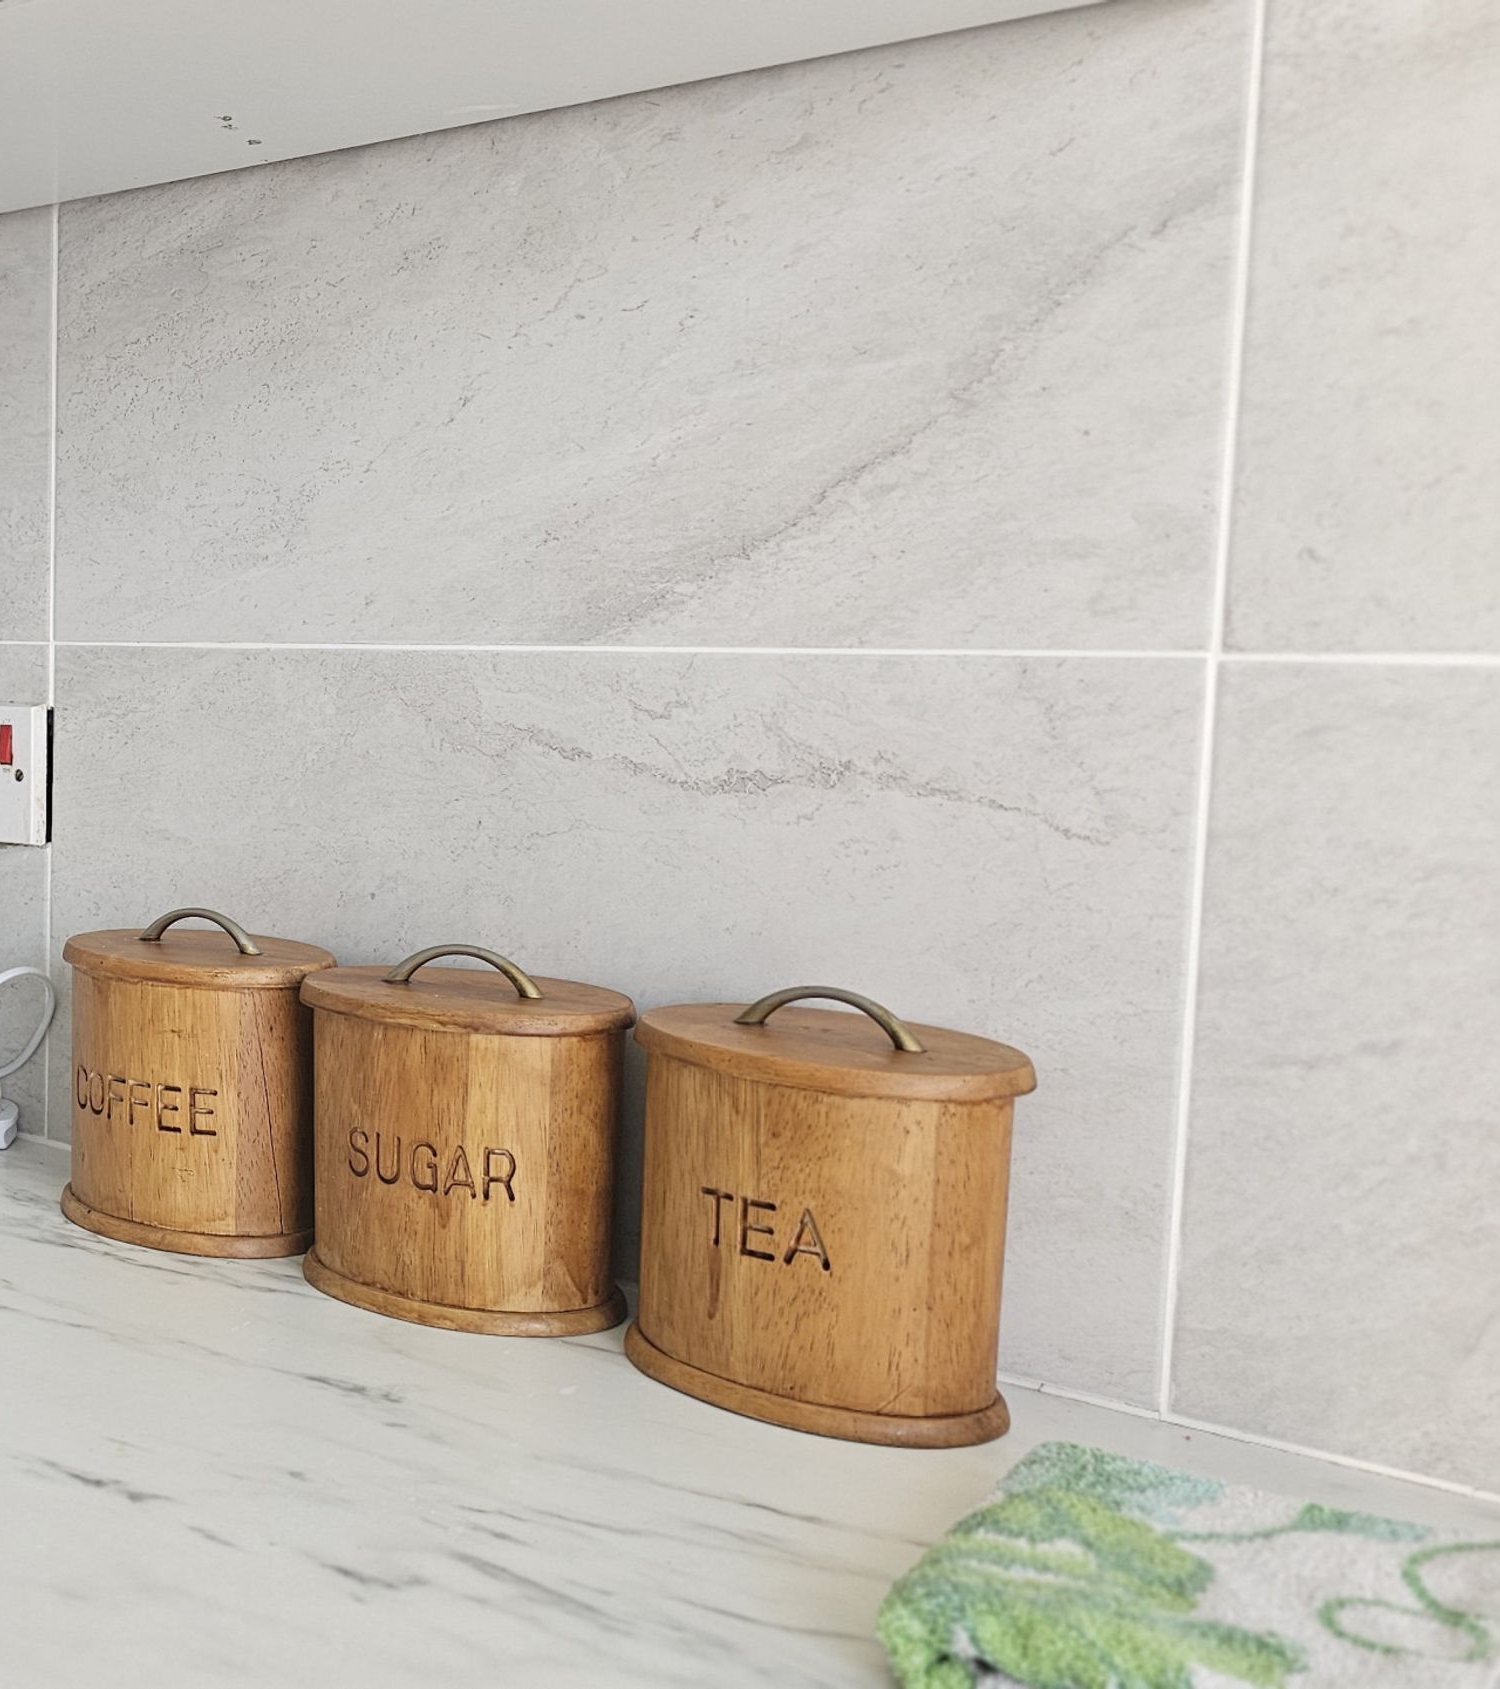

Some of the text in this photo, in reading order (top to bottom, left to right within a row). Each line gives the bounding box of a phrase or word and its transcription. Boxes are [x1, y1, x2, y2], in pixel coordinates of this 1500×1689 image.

[76, 1063, 218, 1137] COFFEE
[347, 1126, 518, 1203] SUGAR
[701, 1186, 834, 1273] TEA
